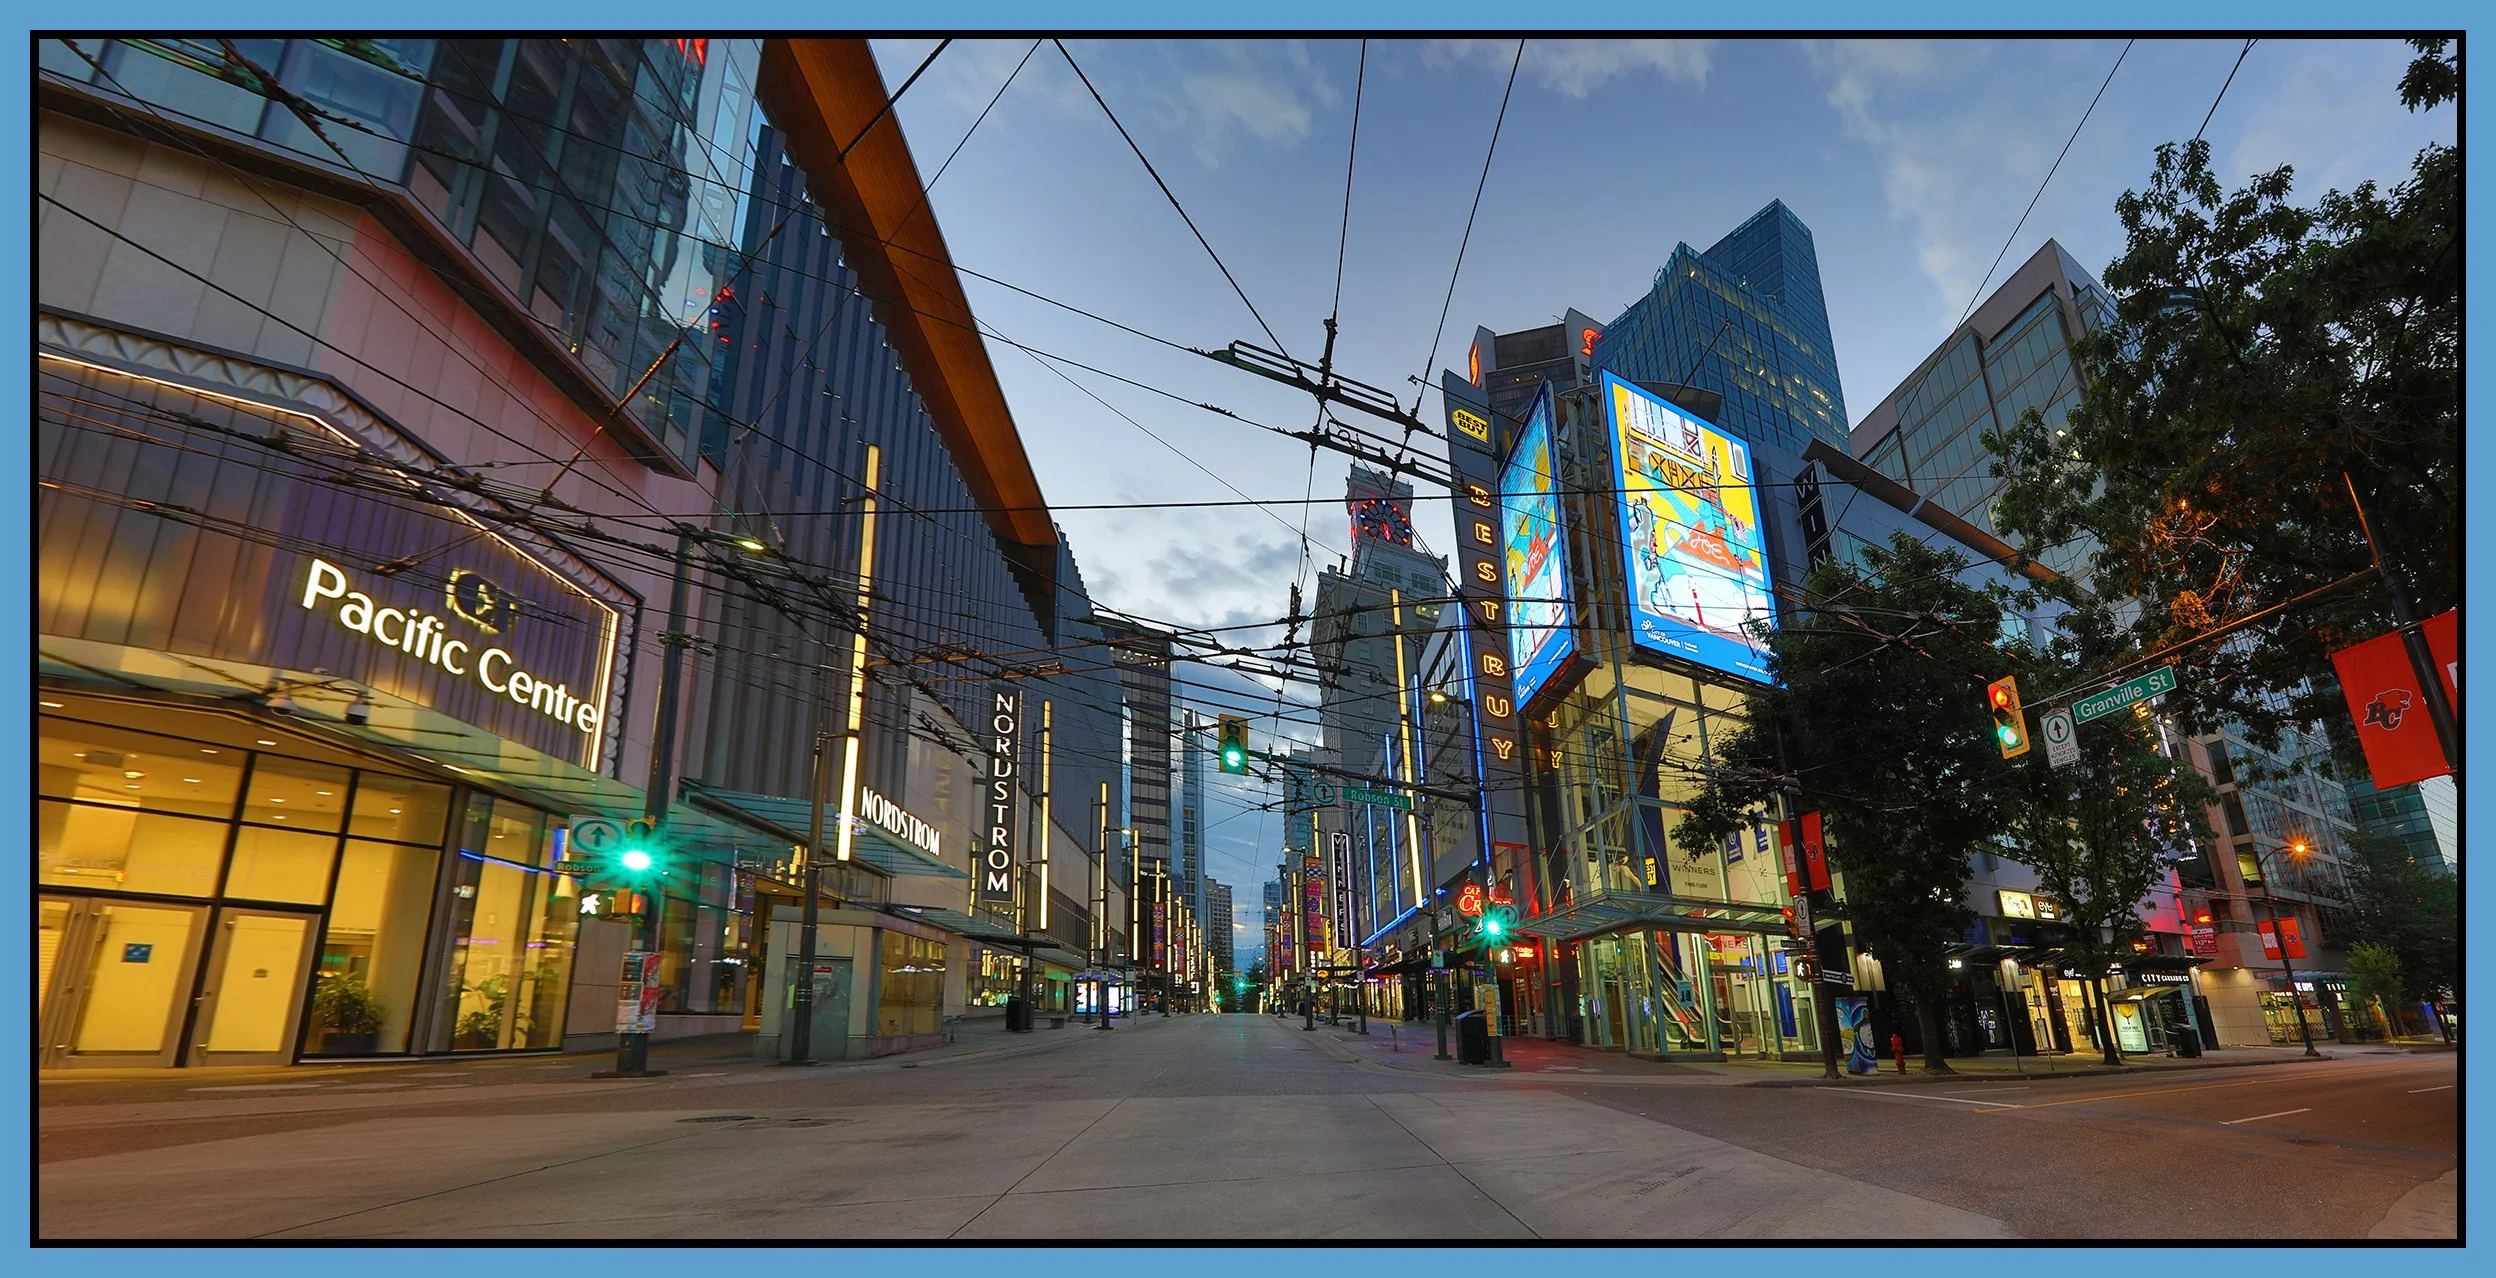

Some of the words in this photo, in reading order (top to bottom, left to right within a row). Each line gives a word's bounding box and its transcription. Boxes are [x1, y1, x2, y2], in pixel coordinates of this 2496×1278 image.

[1457, 411, 1486, 430] BEST
[1458, 419, 1484, 436] BUY
[1470, 484, 1499, 621] BEST
[302, 558, 469, 676] Pacific
[478, 648, 598, 733] Centre
[1646, 632, 1681, 649] VANCOUVER
[2080, 685, 2143, 718] Granville
[2149, 673, 2169, 692] St
[1483, 653, 1513, 761] BUY
[2051, 747, 2076, 759] AUTHORIZED
[2052, 742, 2071, 751] EXCEPT
[2050, 753, 2076, 765] VEHICLES
[987, 693, 1014, 893] NORDSTROM
[1350, 789, 1390, 805] Robson
[1394, 797, 1404, 808] St
[861, 786, 940, 856] NORDSTROM
[1672, 865, 1716, 876] WINNERS
[2141, 974, 2161, 983] CITY
